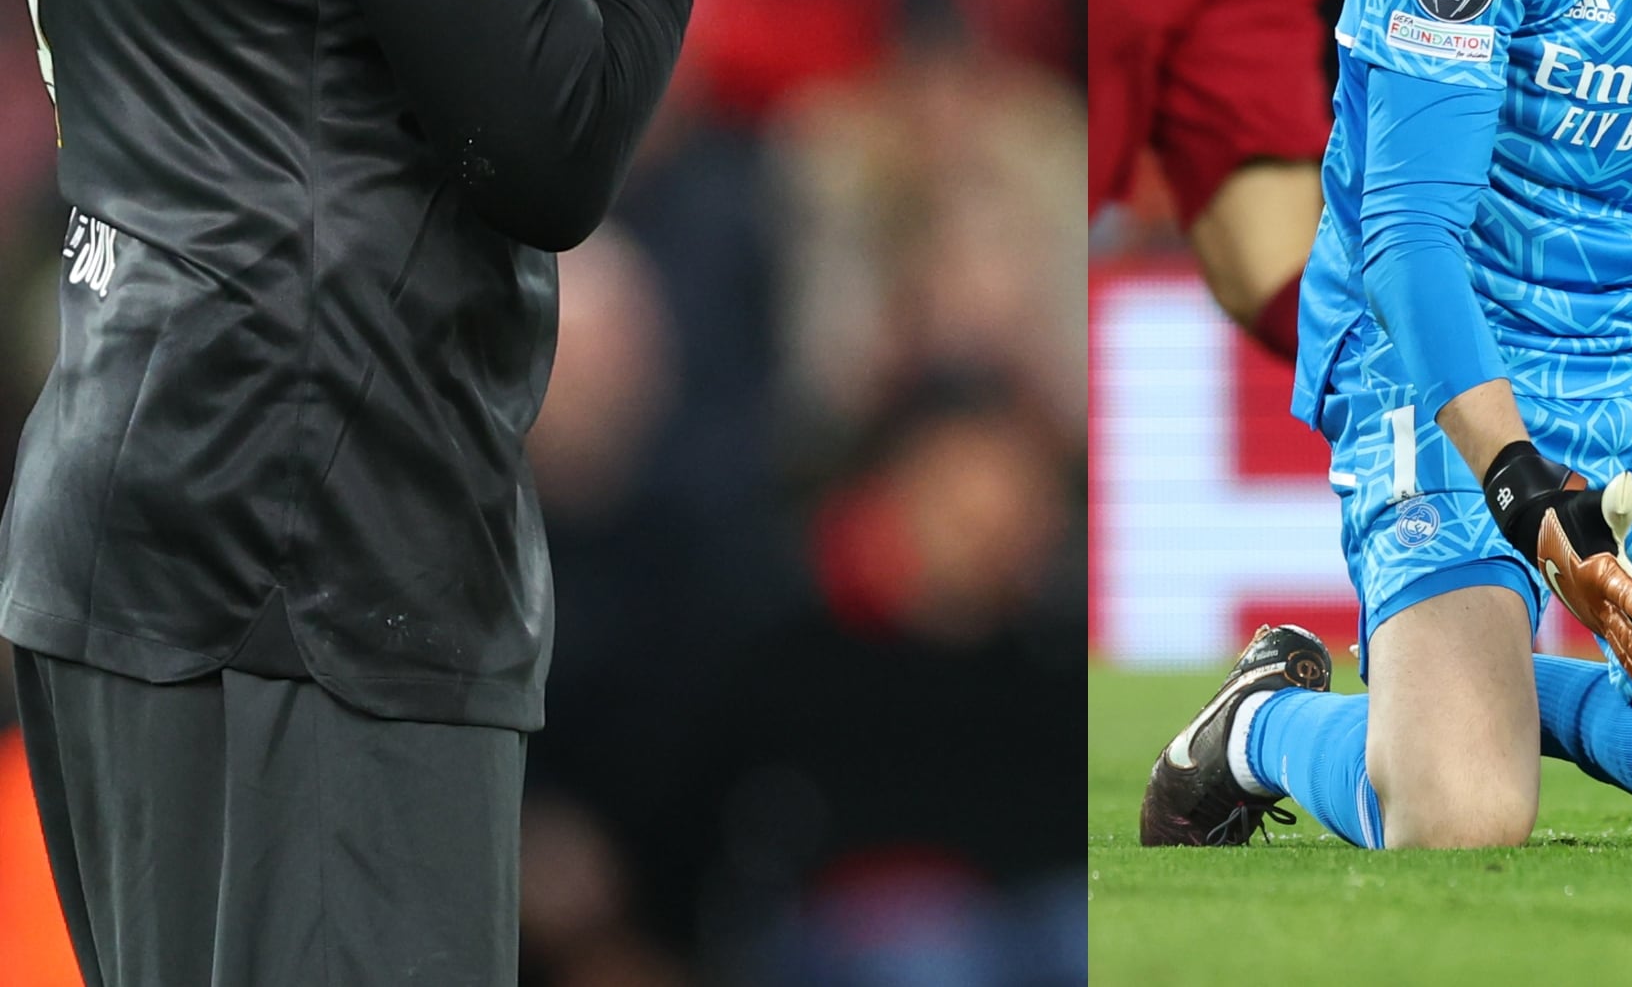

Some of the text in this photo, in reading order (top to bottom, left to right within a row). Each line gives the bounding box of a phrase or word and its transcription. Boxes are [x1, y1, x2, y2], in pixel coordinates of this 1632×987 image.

[1393, 14, 1414, 25] UEFA
[1552, 106, 1617, 149] FLY
[1384, 404, 1425, 505] 1
